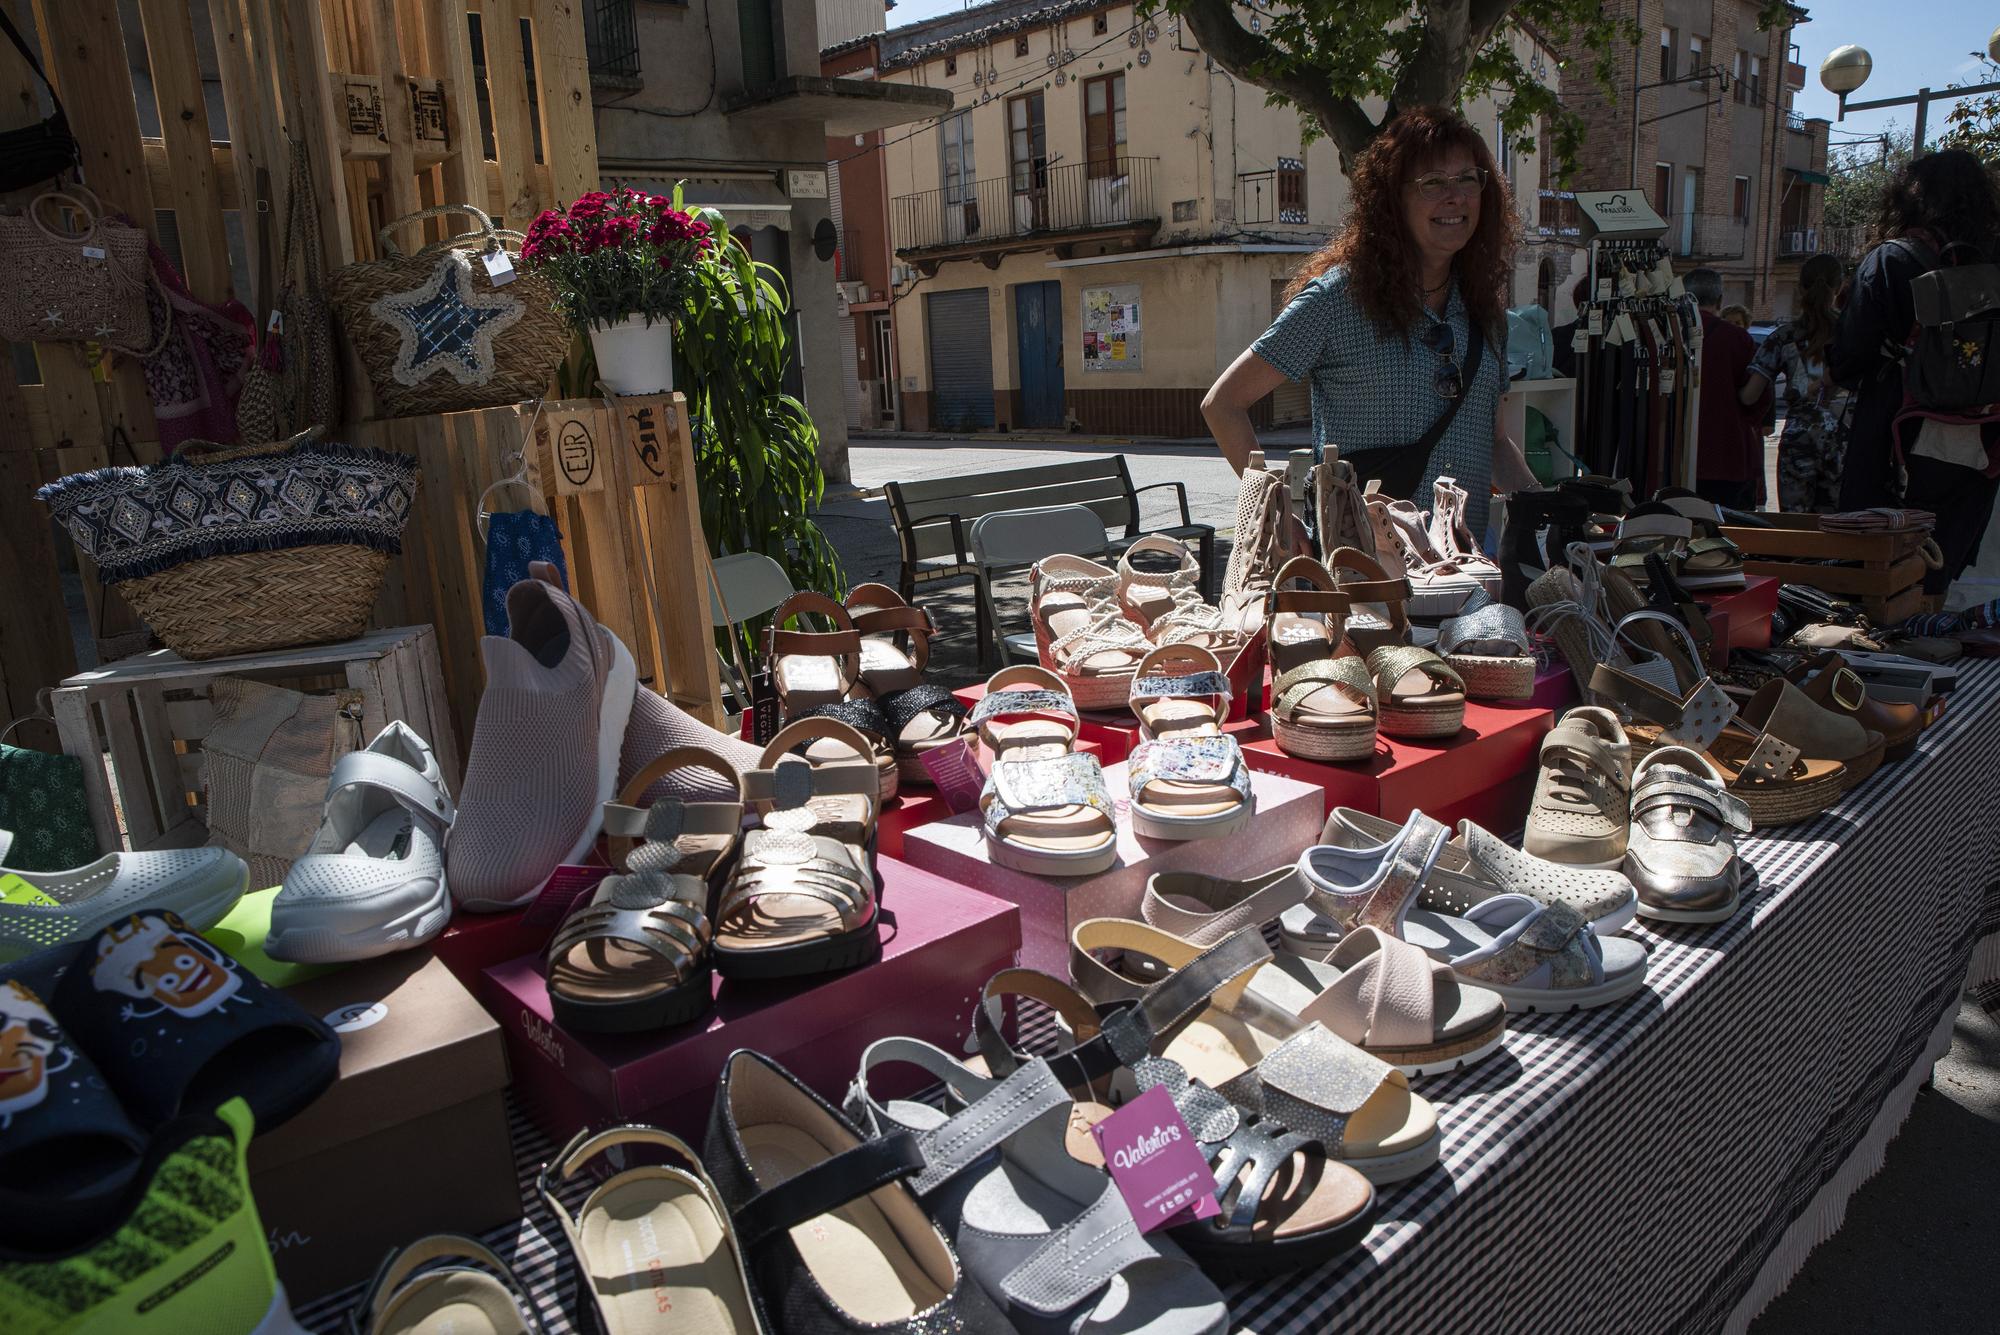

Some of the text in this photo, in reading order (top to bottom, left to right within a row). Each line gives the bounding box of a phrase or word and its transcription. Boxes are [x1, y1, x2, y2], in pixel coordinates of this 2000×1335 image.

[563, 433, 589, 472] EUR
[1113, 1125, 1182, 1169] Valeria's
[1143, 1172, 1199, 1209] www.valerias.es
